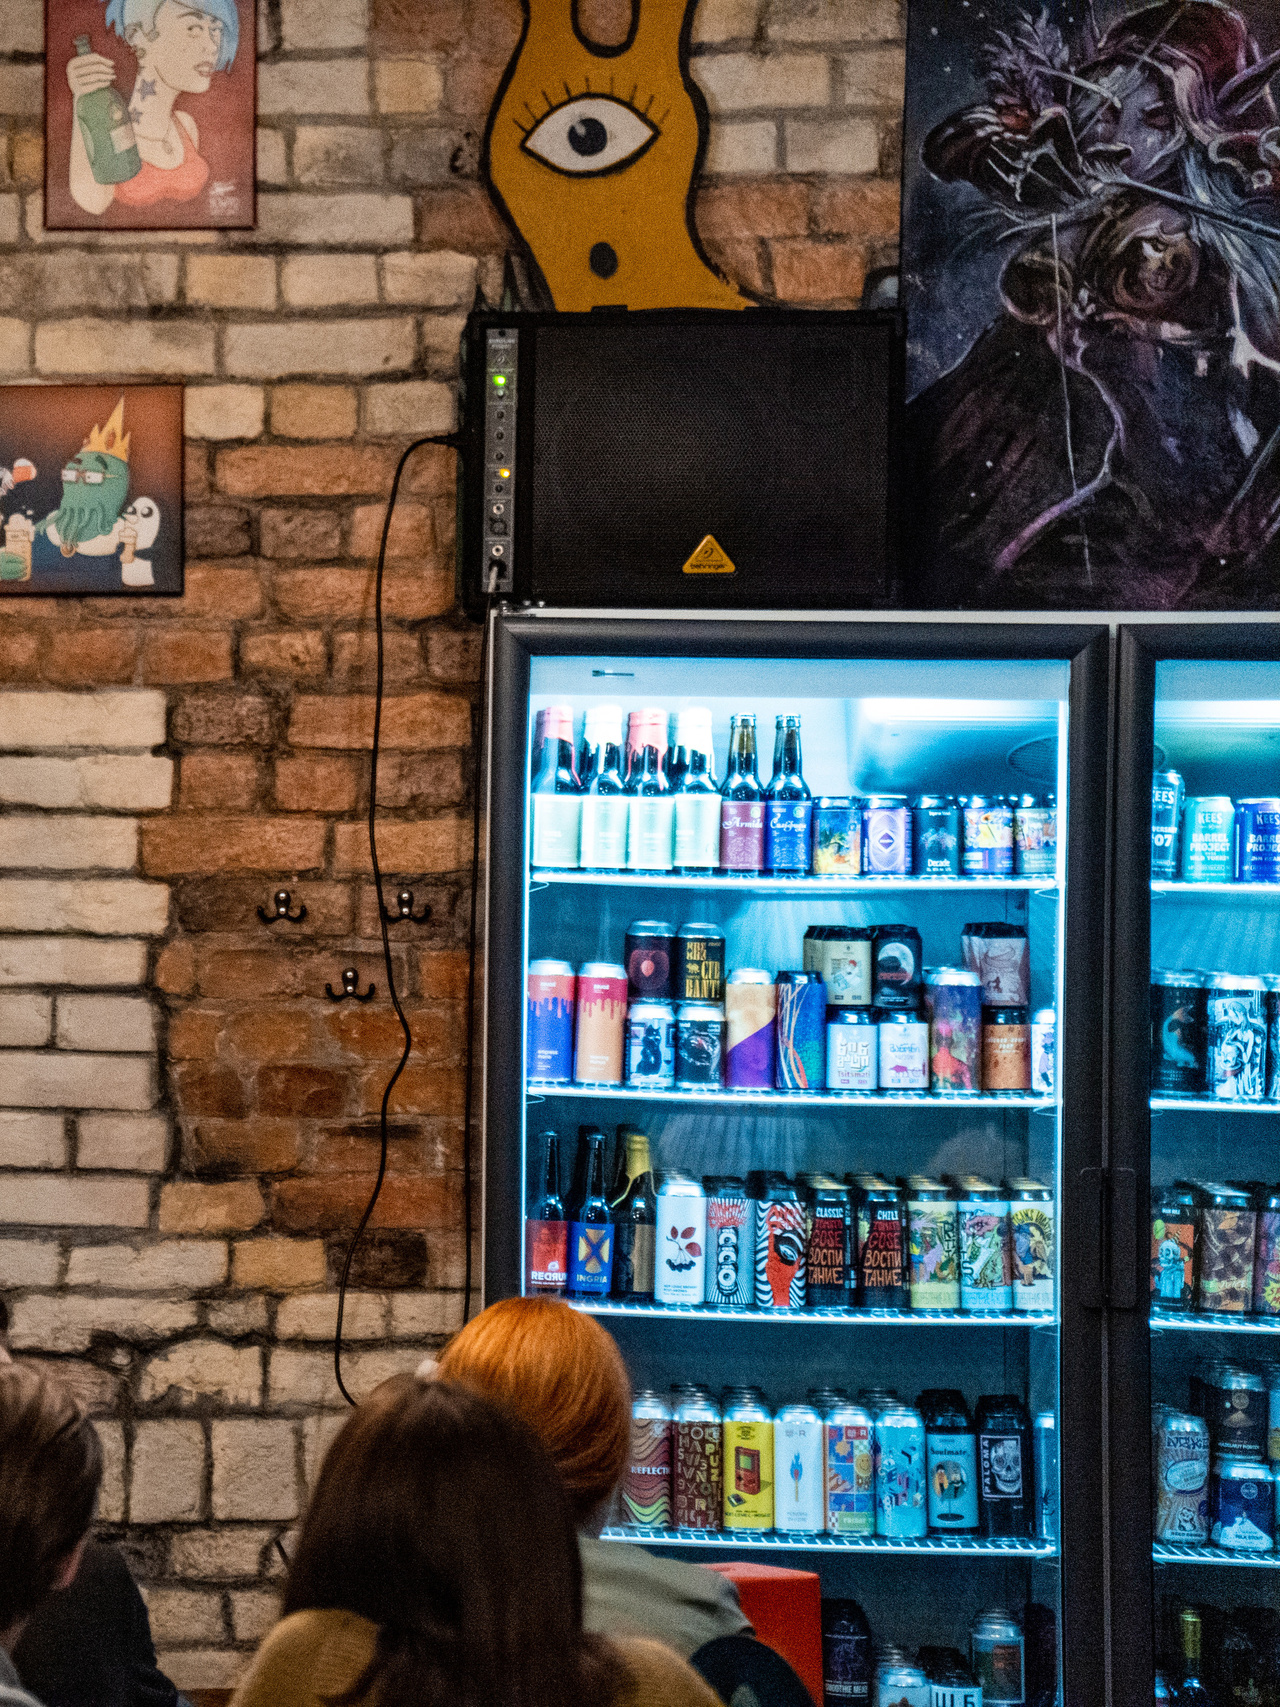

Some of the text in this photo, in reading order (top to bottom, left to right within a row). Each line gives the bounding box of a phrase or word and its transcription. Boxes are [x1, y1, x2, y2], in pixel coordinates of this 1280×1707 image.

[690, 562, 727, 570] behringer
[1190, 843, 1230, 852] PROJECT
[816, 1208, 843, 1218] CLASSIC
[811, 1230, 843, 1247] GOSE
[868, 1232, 901, 1249] GOSE
[808, 1247, 843, 1265] ВОСПИ
[863, 1249, 901, 1267] ВОСПИ
[576, 1274, 607, 1283] INGRIA
[808, 1266, 843, 1284] ТАНИЕ
[863, 1268, 902, 1286] ТАНИЕ
[931, 1447, 966, 1456] Soulmate
[983, 1439, 991, 1493] PALOMA
